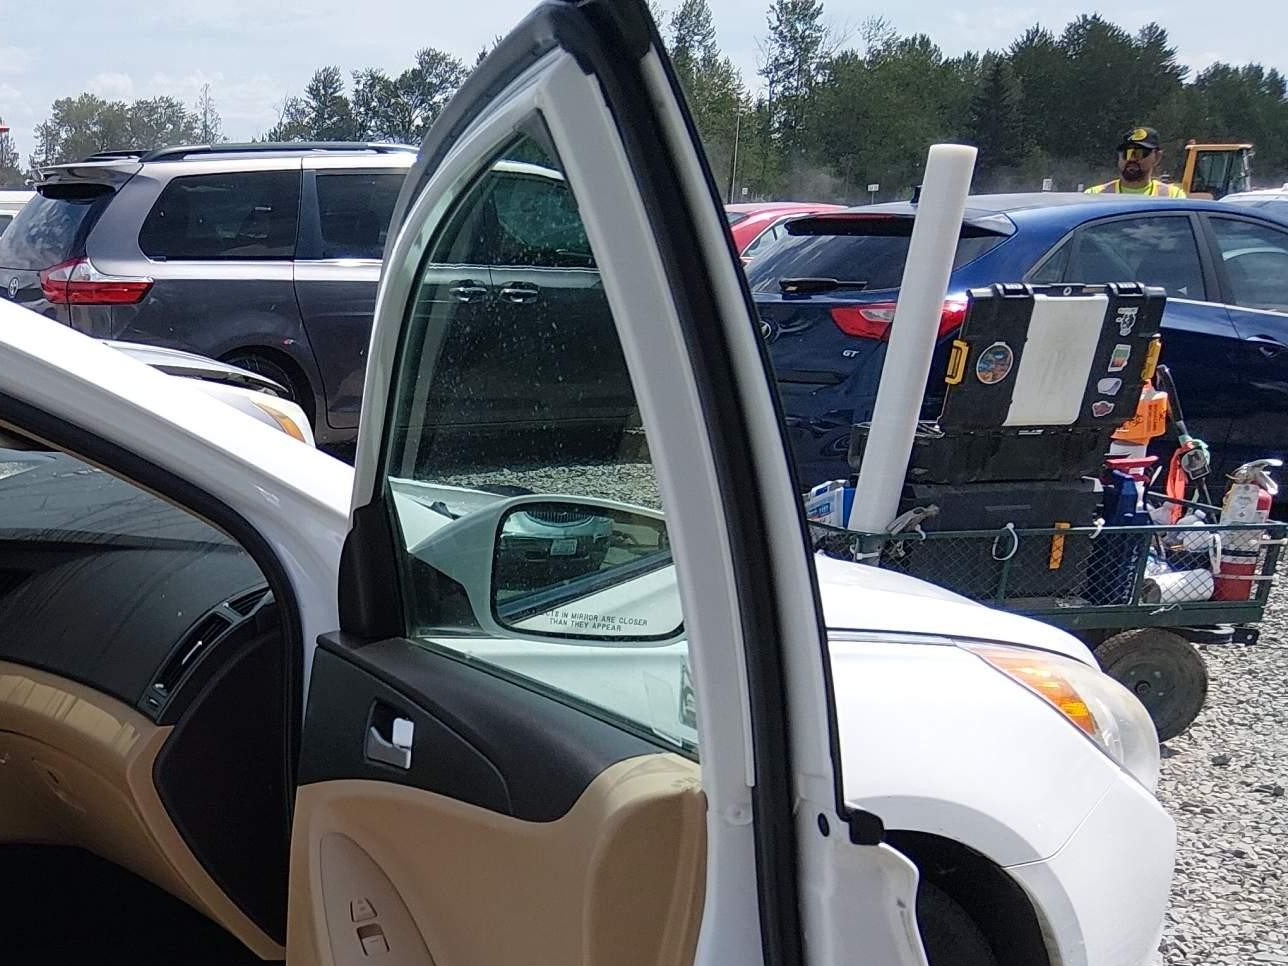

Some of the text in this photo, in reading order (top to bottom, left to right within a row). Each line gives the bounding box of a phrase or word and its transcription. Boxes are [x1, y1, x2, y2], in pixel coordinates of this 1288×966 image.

[842, 349, 860, 358] GT
[550, 617, 622, 633] THAN THEY APPEAR
[561, 611, 569, 619] IN
[571, 612, 599, 623] MIRROR
[601, 615, 616, 624] ARE
[618, 616, 648, 627] CLOSER
